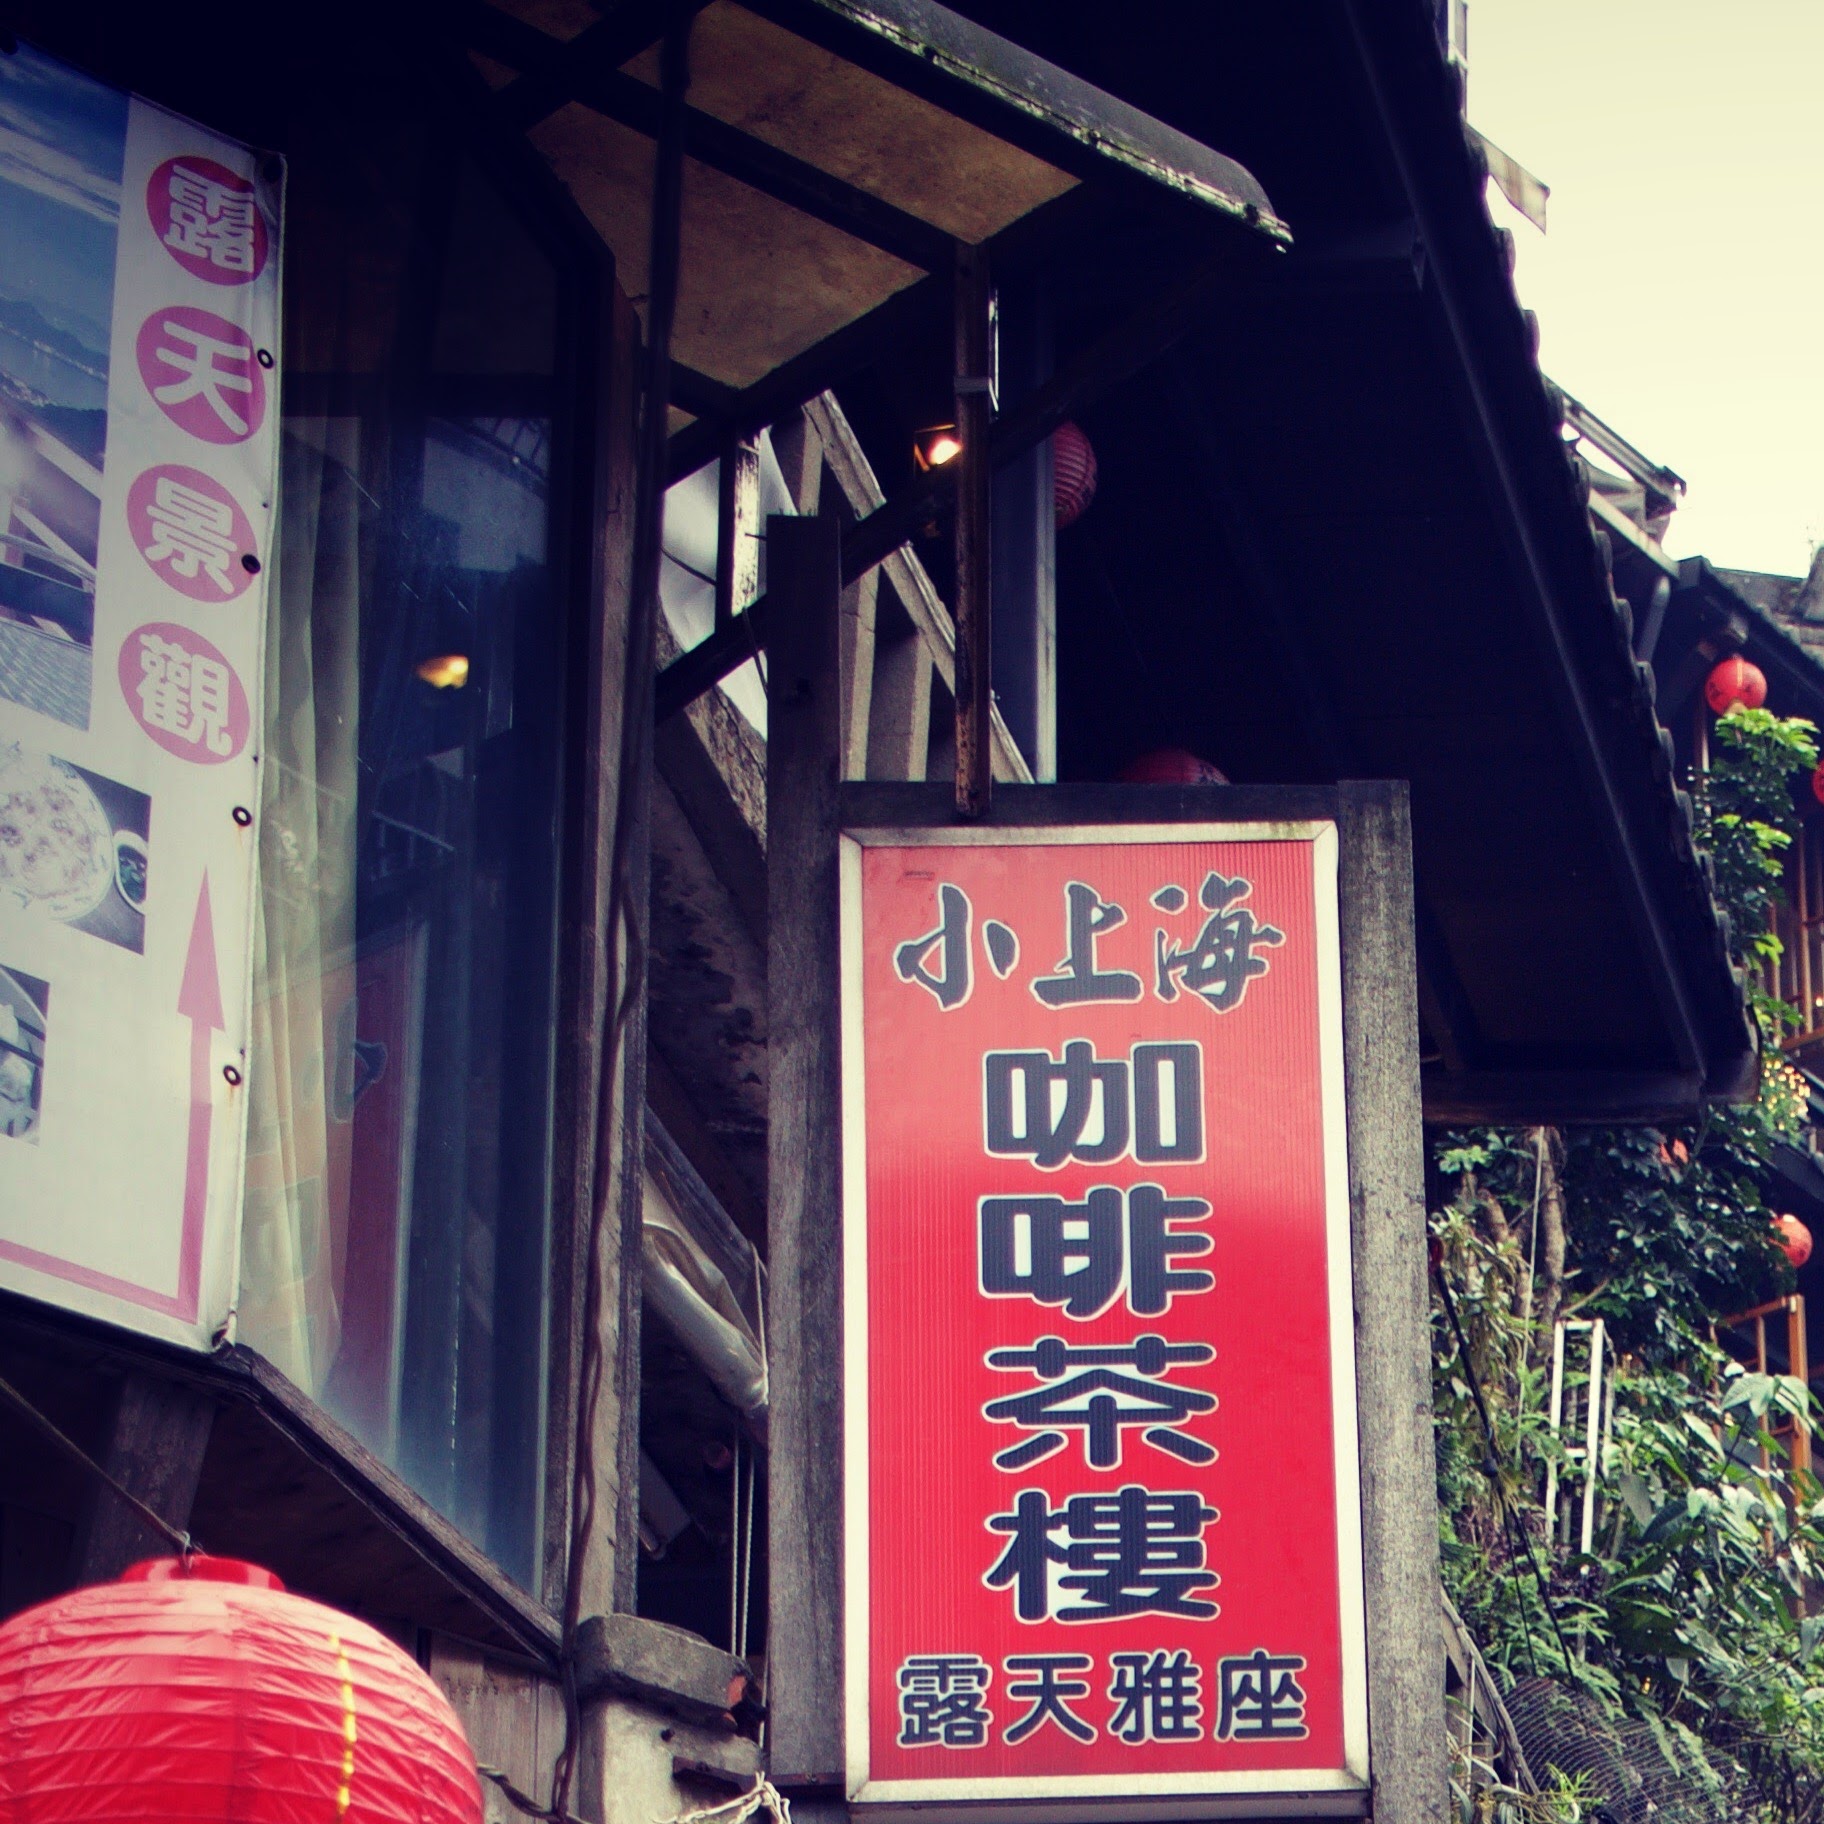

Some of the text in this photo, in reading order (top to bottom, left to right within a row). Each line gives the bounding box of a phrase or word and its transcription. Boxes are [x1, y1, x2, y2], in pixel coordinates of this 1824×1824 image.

[140, 164, 255, 751] 露天景觀
[894, 871, 1286, 1014] 小上海
[978, 1039, 1222, 1626] 咖啡茶樓
[896, 1649, 1309, 1750] 露天雅座
